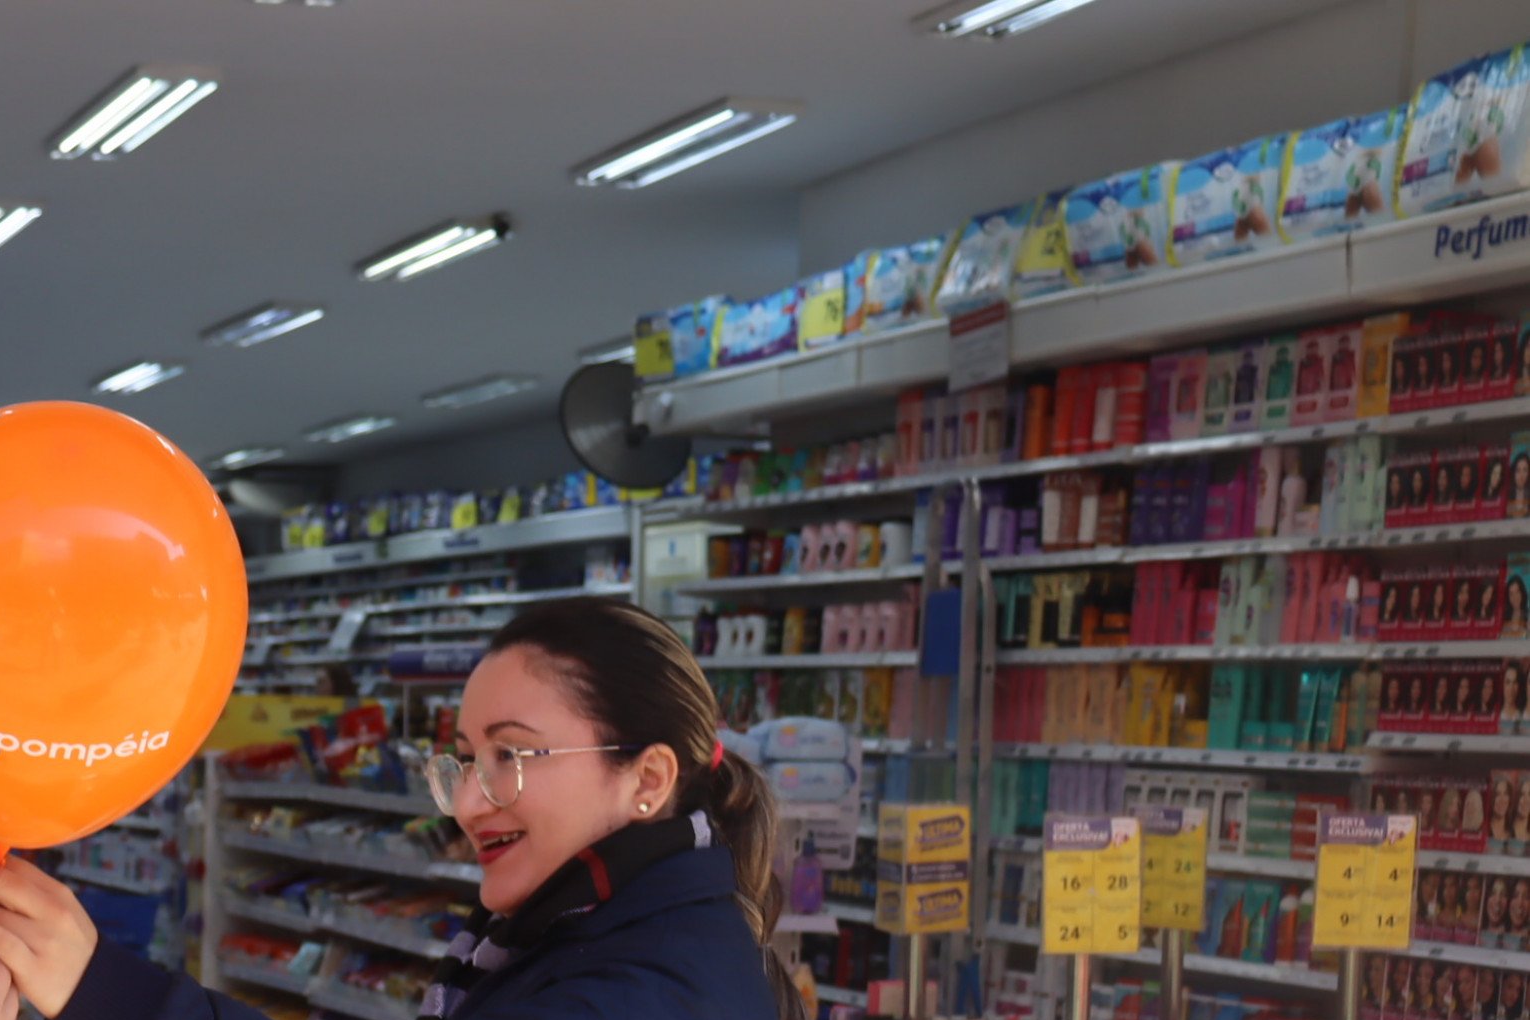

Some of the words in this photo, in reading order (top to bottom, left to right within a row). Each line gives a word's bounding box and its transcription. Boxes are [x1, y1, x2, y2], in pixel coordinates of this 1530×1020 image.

[1061, 875, 1082, 892] 16
[1107, 875, 1129, 891] 28
[1377, 914, 1395, 929] 14
[1059, 926, 1082, 942] 24
[1118, 925, 1129, 941] 5
